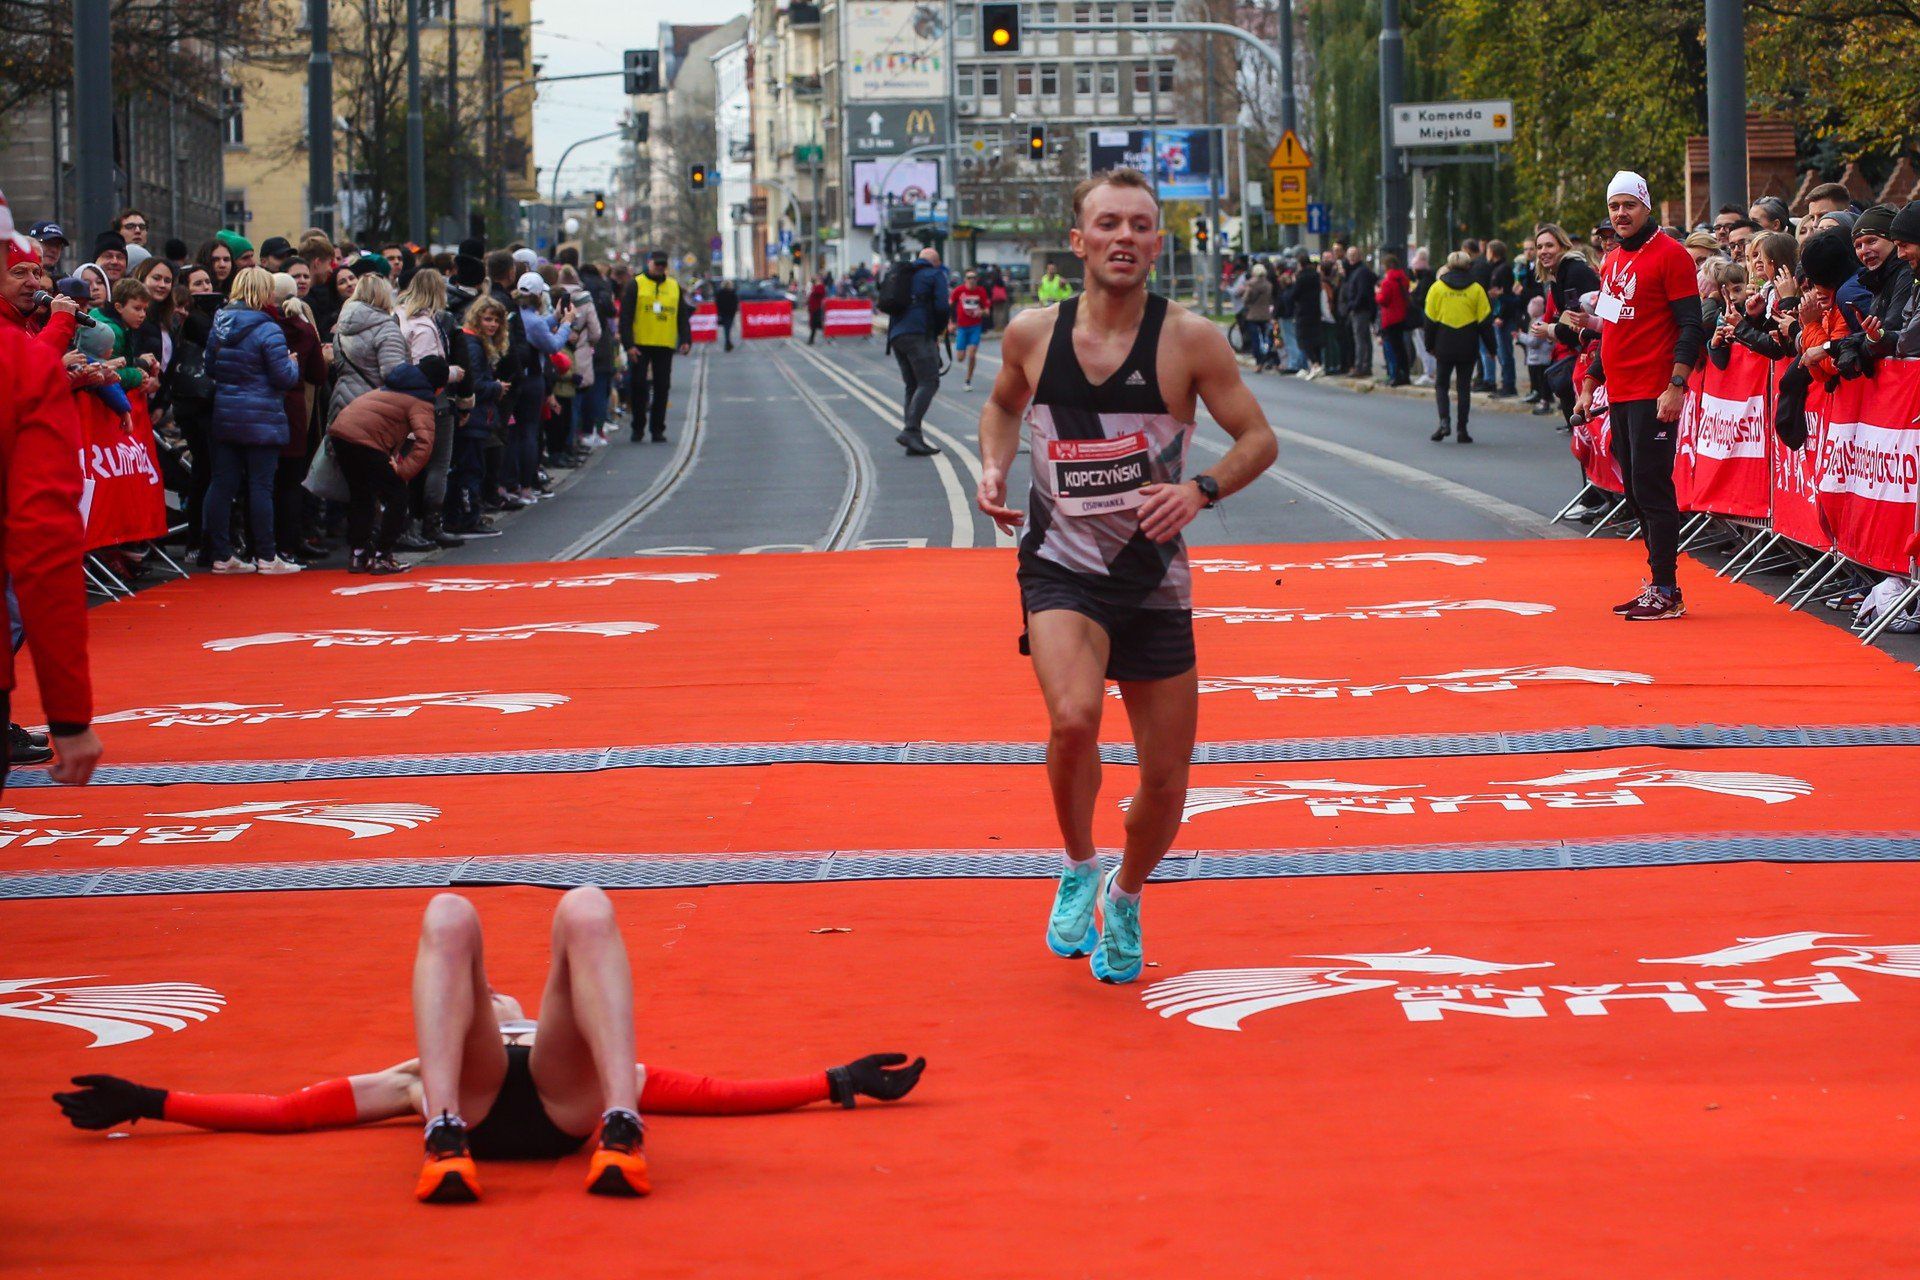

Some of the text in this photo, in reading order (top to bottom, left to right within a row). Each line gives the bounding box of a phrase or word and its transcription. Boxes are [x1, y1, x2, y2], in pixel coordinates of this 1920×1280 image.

[1418, 109, 1482, 121] Komenda
[1419, 126, 1471, 140] Miejska
[1805, 411, 1819, 436] UN
[1064, 462, 1142, 488] KOPCZYŃSKI
[1309, 795, 1645, 817] RUN
[0, 829, 246, 849] RU
[1393, 971, 1840, 1001] POLAND
[1401, 982, 1861, 1022] RUN
